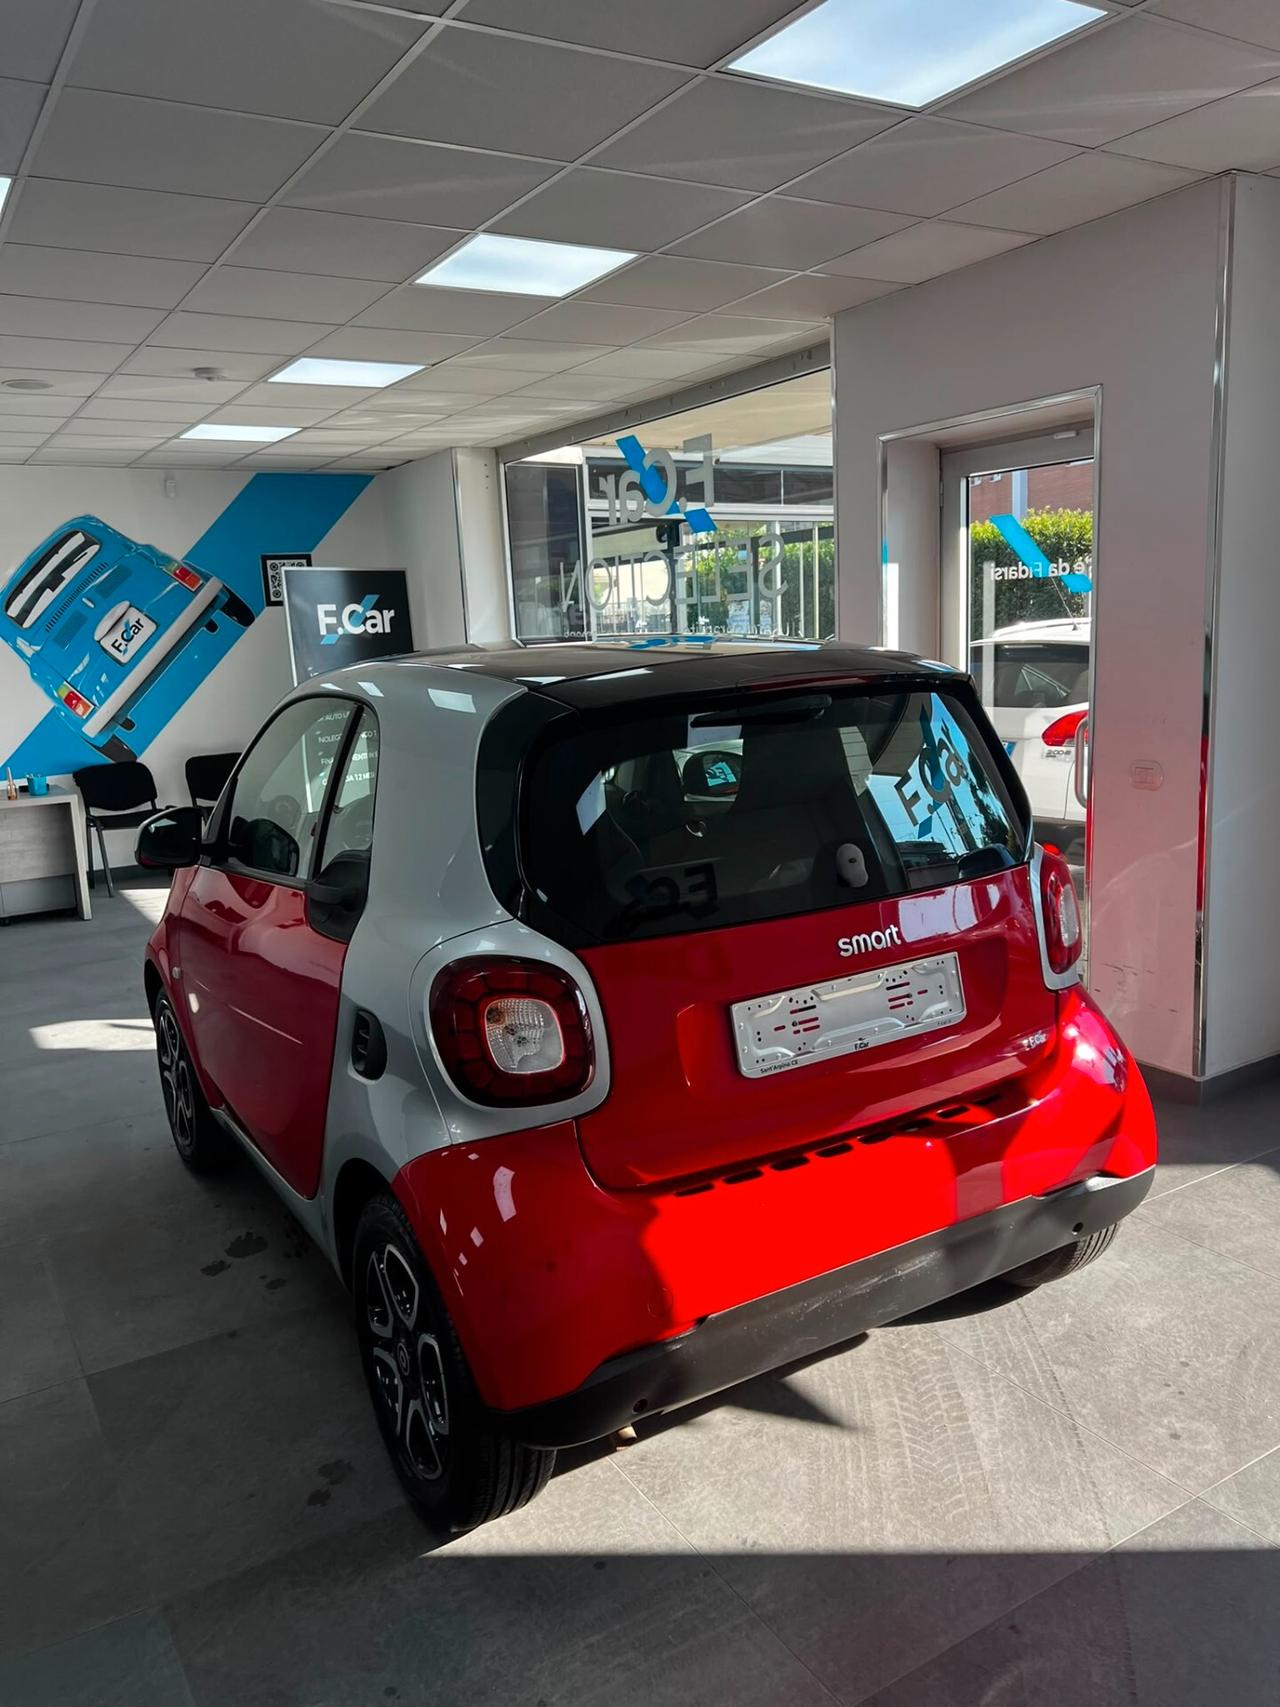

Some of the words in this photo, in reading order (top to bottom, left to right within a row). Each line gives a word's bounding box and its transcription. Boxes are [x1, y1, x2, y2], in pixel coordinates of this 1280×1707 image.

[110, 618, 145, 653] F.Car
[317, 603, 395, 636] F.Car
[838, 924, 901, 957] smart
[854, 1041, 870, 1051] F.Car
